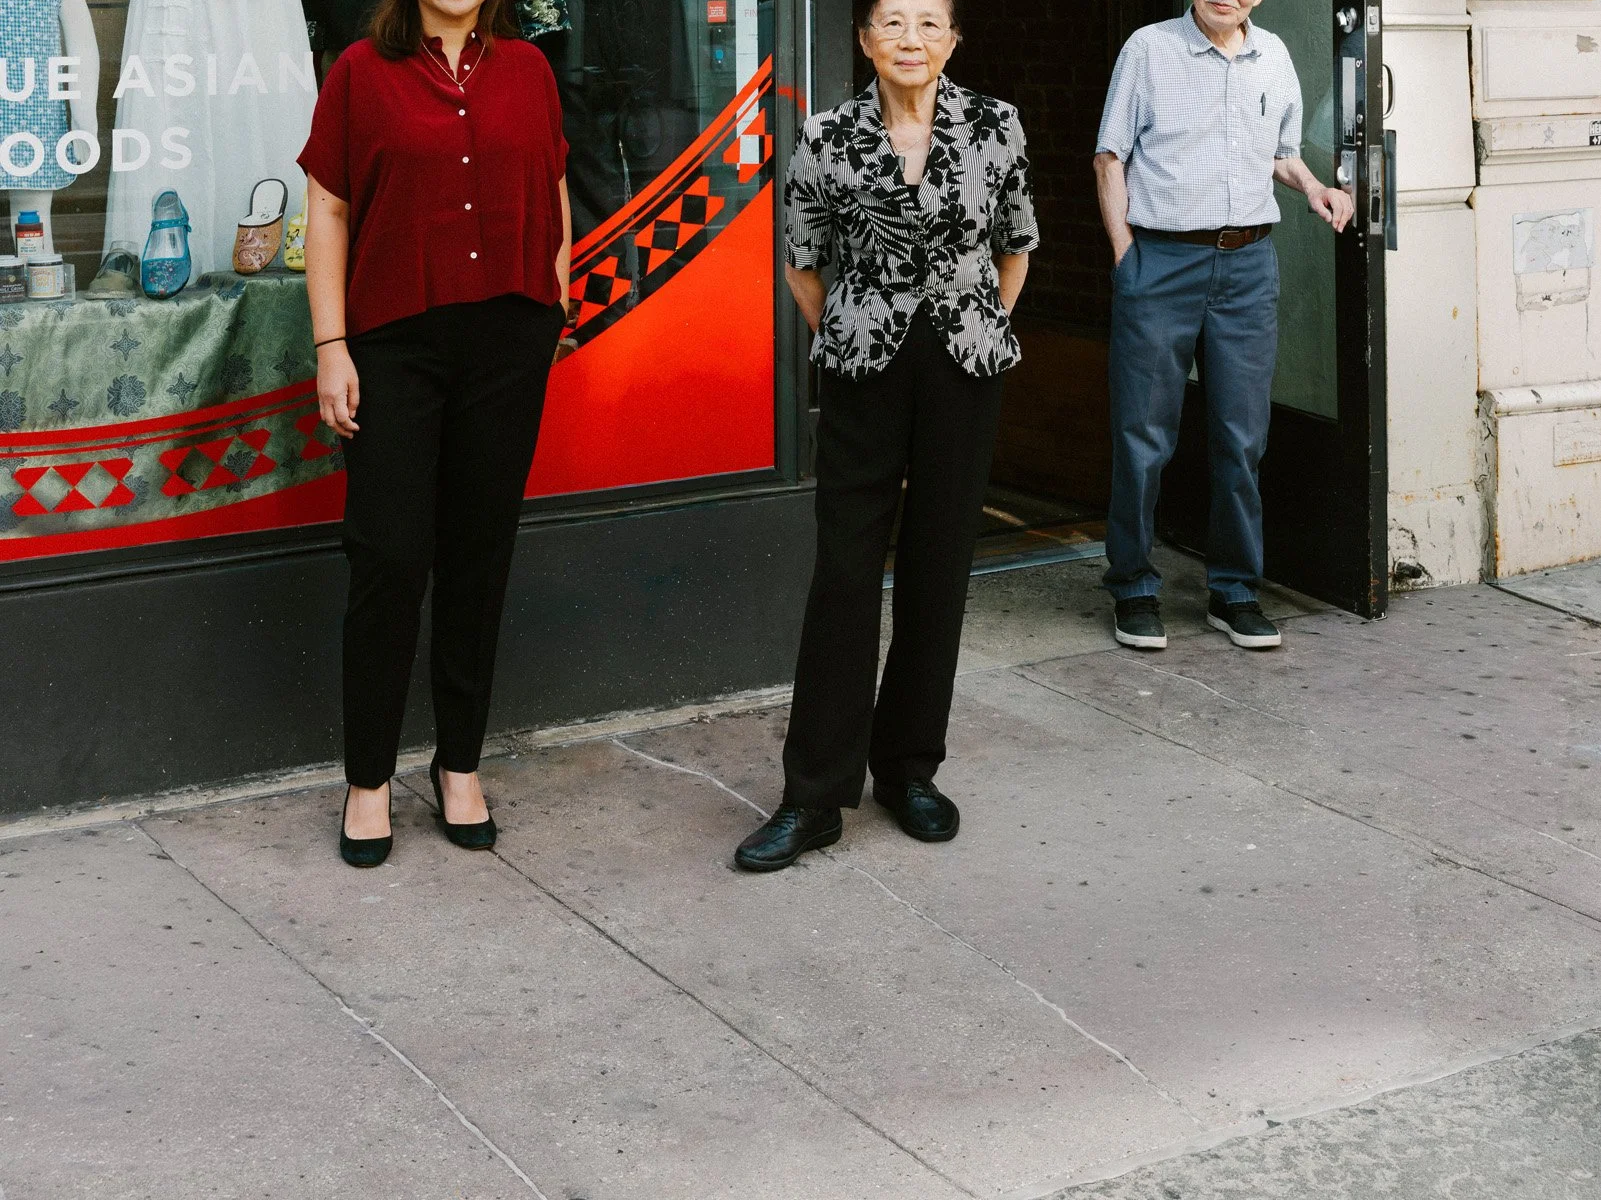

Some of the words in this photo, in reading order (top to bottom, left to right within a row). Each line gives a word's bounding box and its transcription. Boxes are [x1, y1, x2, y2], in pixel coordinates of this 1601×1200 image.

[0, 55, 82, 102] UE
[112, 51, 315, 99] ASIAN
[0, 126, 192, 177] OODS
